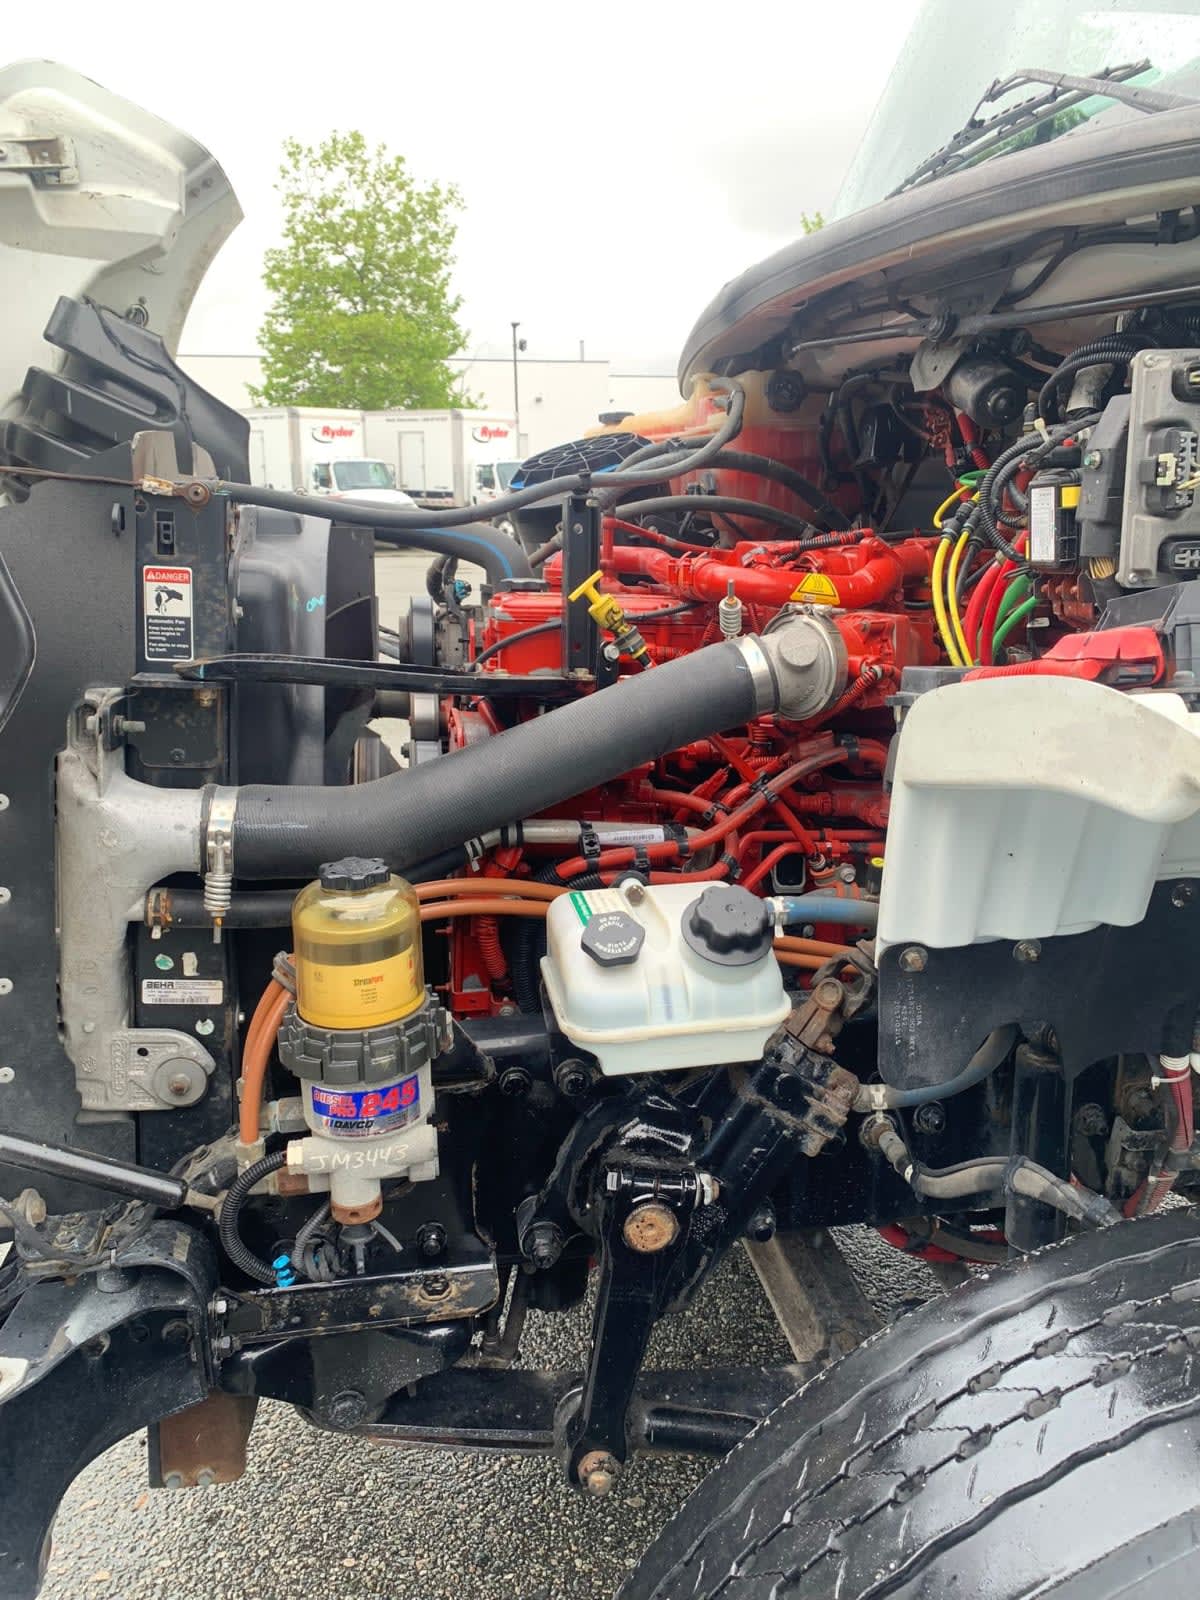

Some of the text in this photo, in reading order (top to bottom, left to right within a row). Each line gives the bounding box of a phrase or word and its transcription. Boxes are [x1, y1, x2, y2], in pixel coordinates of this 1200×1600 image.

[321, 426, 355, 439] Ryder
[479, 426, 509, 440] Ryder
[154, 571, 190, 582] DANGER
[146, 981, 175, 989] BEHR
[313, 1089, 353, 1105] DIESEL
[359, 1078, 418, 1118] 245
[328, 1103, 357, 1118] PRO
[333, 1120, 375, 1129] DAVCO
[309, 1144, 410, 1170] JM3443
